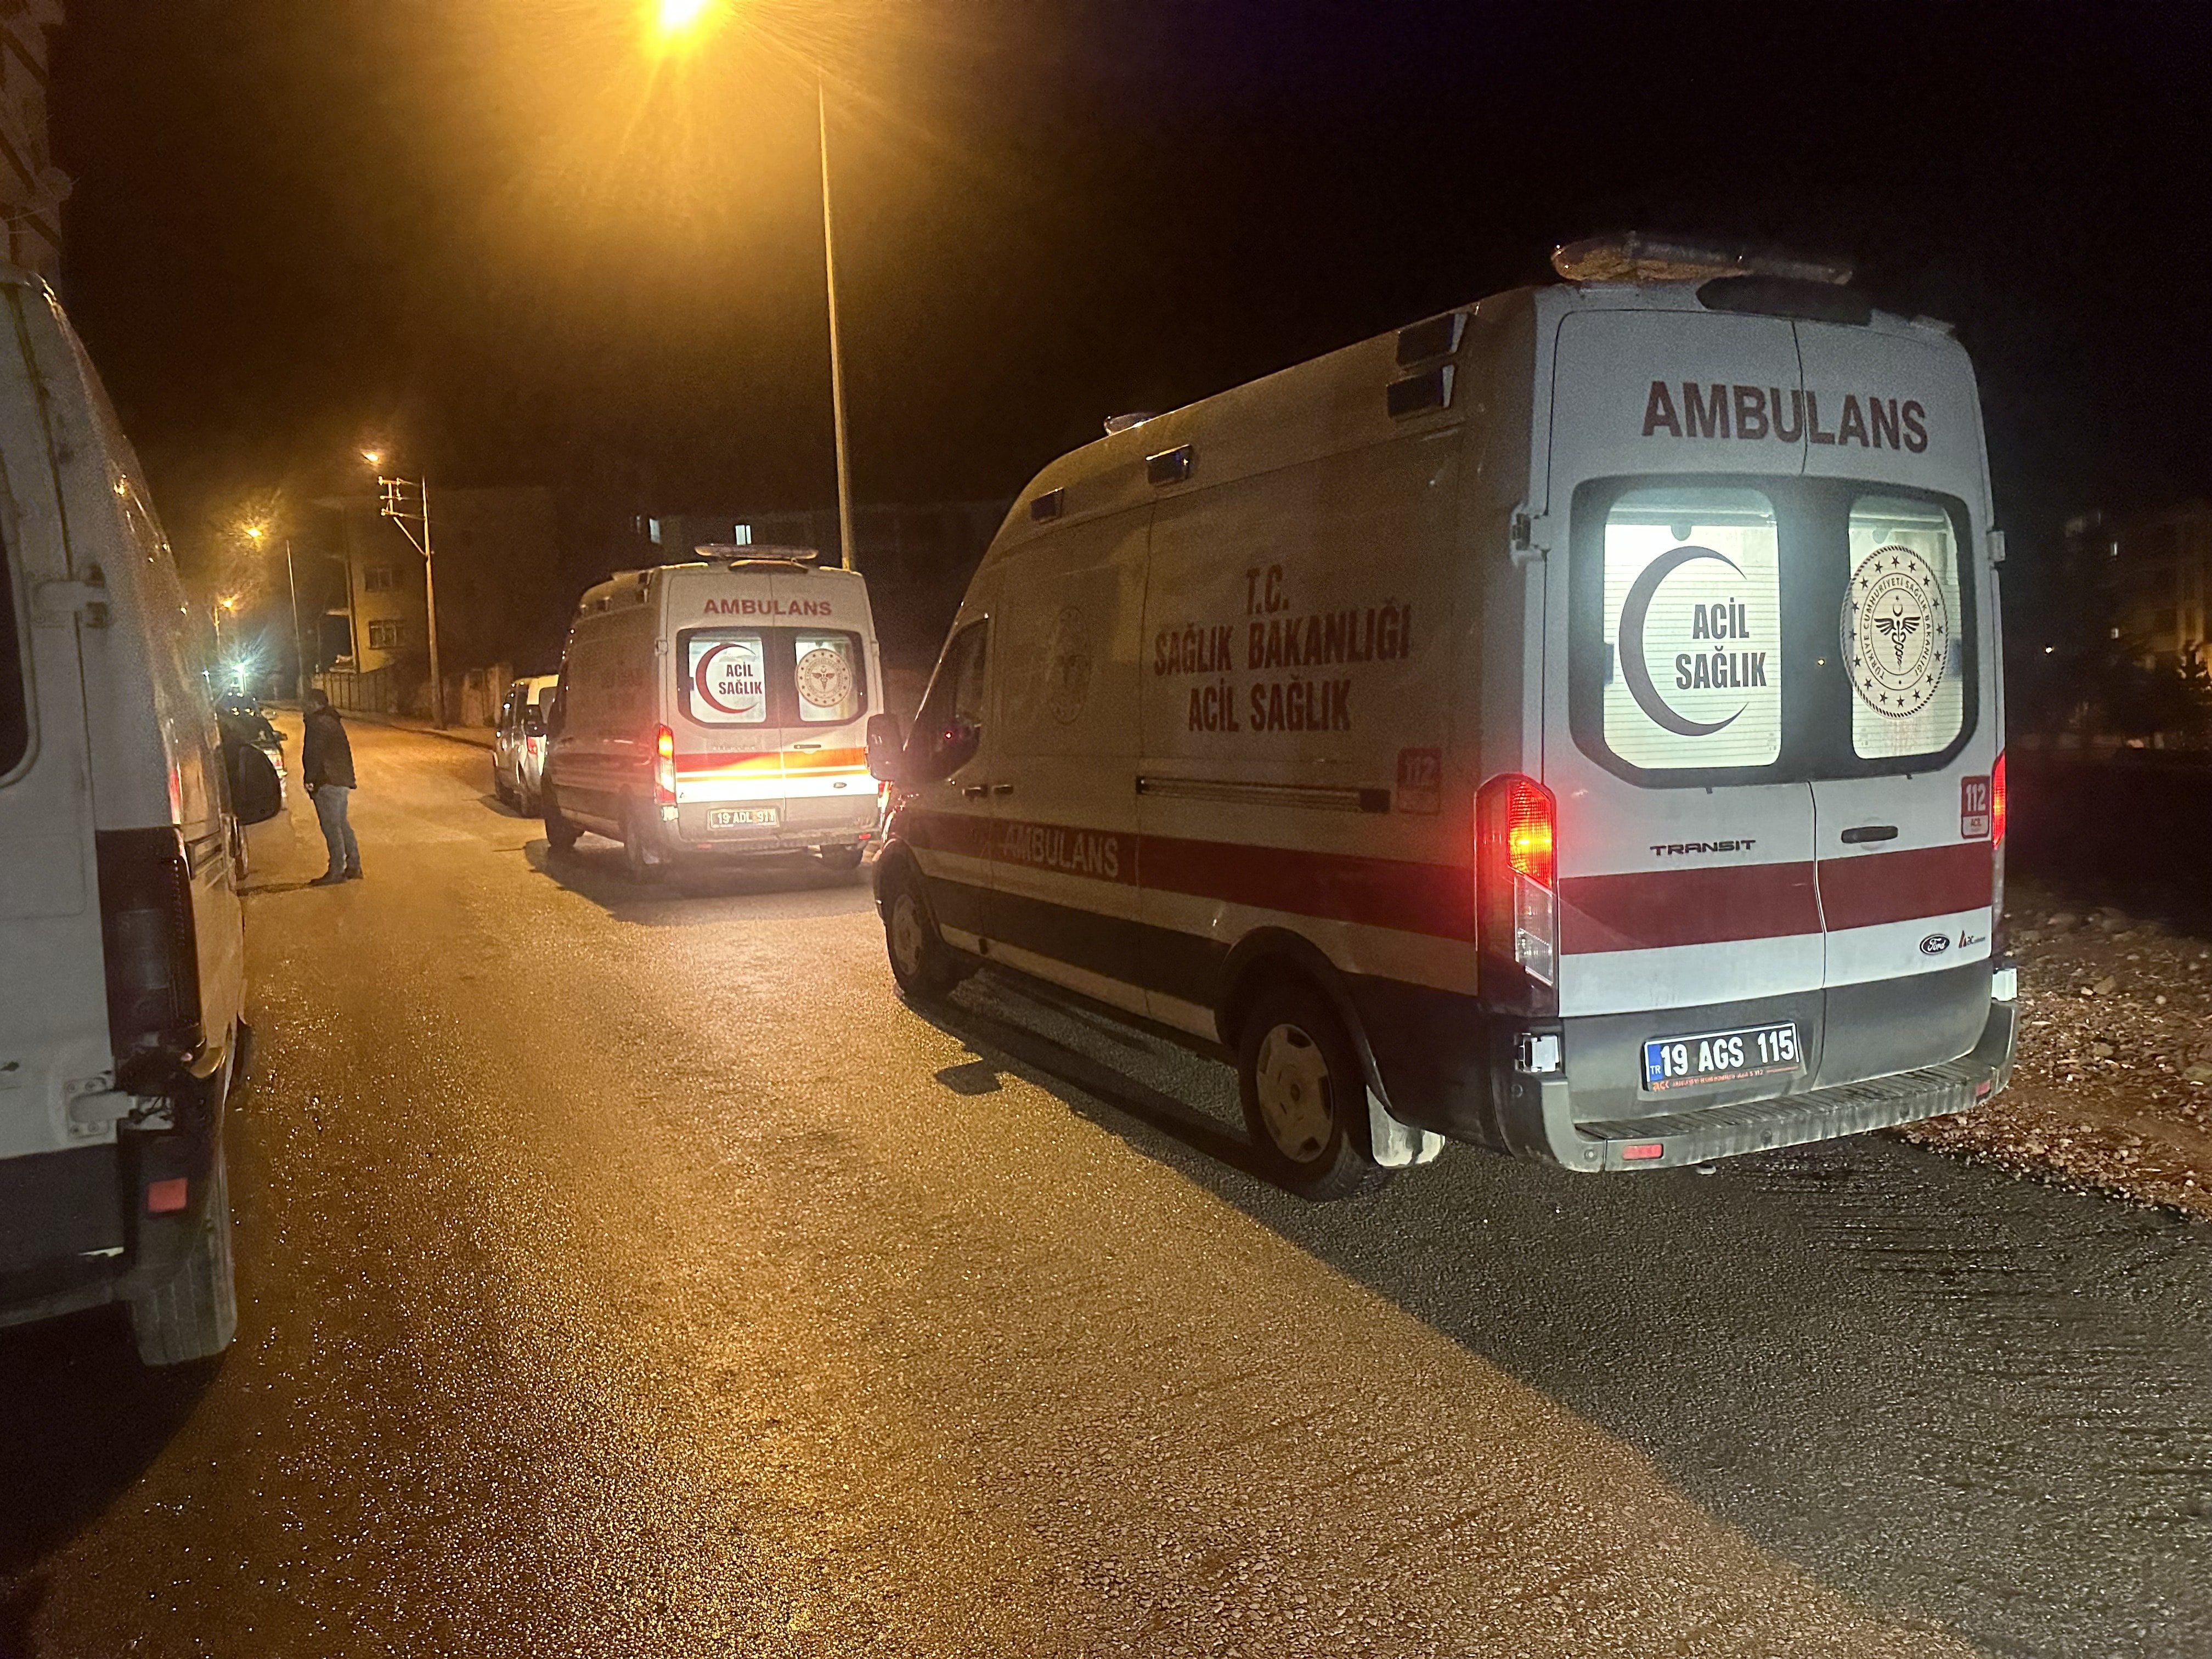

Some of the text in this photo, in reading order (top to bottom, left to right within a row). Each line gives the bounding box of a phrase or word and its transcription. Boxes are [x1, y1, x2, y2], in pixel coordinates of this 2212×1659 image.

[1643, 381, 1928, 453] AMBULANS
[704, 599, 832, 616] AMBULANS
[1246, 563, 1289, 614] T.C.
[1154, 596, 1411, 675] SAĞLIK BAKANLIĞI
[1692, 597, 1750, 639] ACİL
[719, 679, 763, 695] SAĞLIK
[726, 662, 753, 677] ACİL
[1675, 646, 1767, 690] SAĞLIK
[1188, 673, 1351, 732] ACİL SAĞLIK
[718, 812, 730, 823] 19
[733, 812, 753, 823] ADL
[1966, 783, 1986, 811] 112
[1000, 823, 1119, 878] AMBULANS
[1650, 840, 1756, 856] TRANSIT
[1650, 1065, 1661, 1075] TR
[1661, 1030, 1794, 1076] 19 AGS 115
